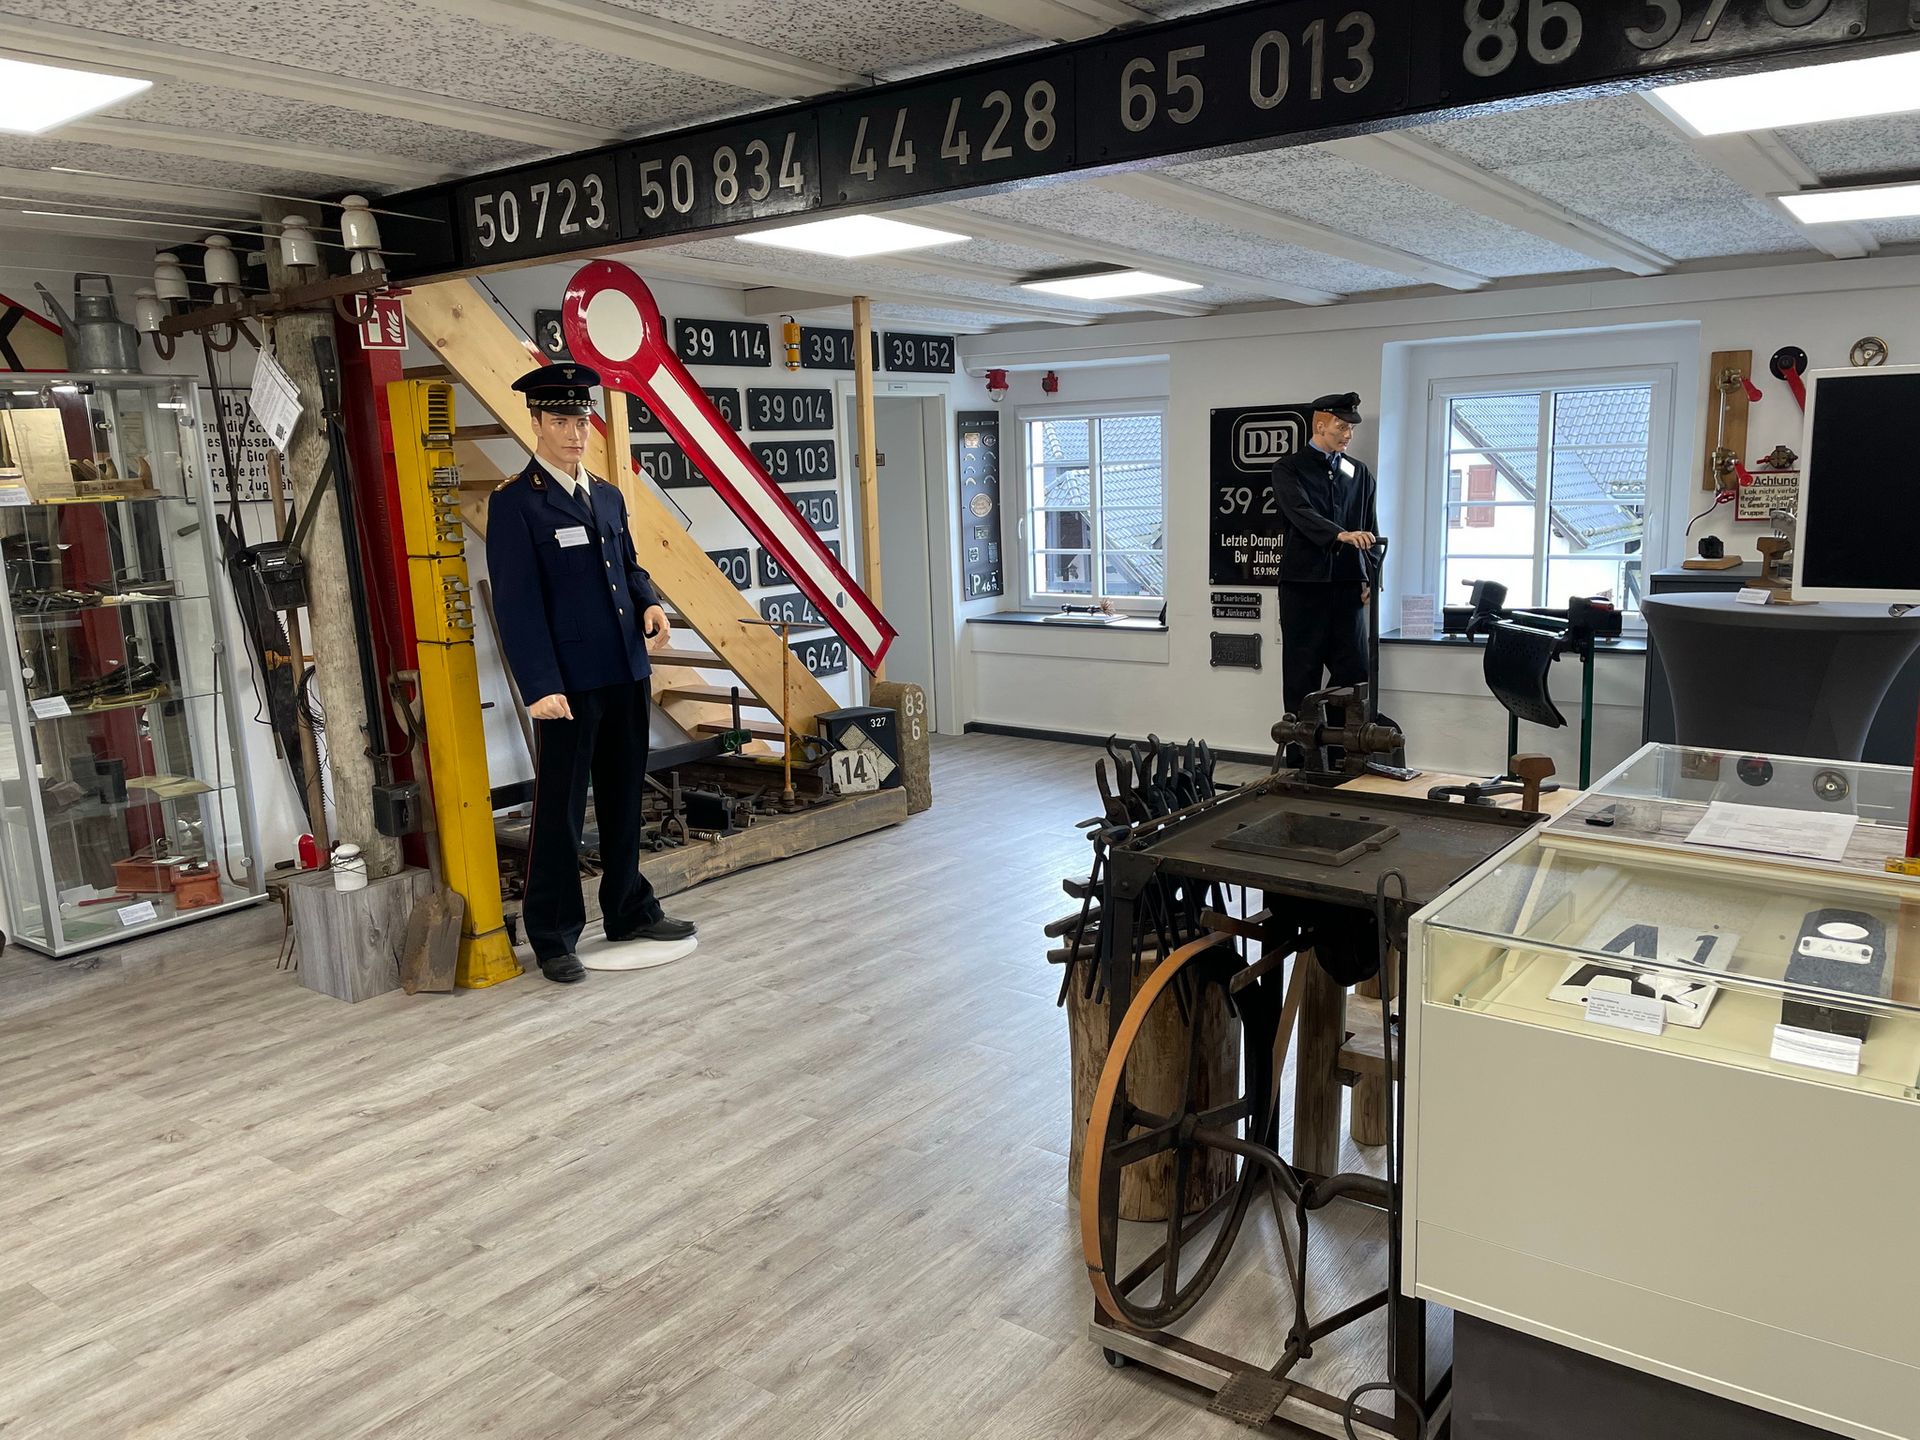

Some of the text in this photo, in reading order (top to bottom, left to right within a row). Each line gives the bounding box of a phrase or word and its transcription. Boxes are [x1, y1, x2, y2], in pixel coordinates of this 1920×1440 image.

[1120, 11, 1376, 132] 65 013
[850, 80, 1056, 181] 44 428
[640, 132, 804, 219] 50 834
[474, 173, 605, 247] 50 723
[546, 320, 563, 353] 3
[684, 326, 766, 359] 39 114
[810, 334, 835, 362] 39
[892, 339, 950, 368] 39 152
[758, 394, 826, 423] 39 014
[1246, 429, 1290, 456] DB
[640, 451, 672, 480] 50
[761, 446, 829, 475] 39 103
[796, 498, 834, 525] 250
[1219, 487, 1278, 515] 39 2
[1221, 533, 1284, 549] Letzte Dampfl
[717, 555, 747, 584] 20
[1234, 550, 1283, 564] Bw Jünke
[973, 574, 981, 594] P
[769, 602, 795, 629] 86
[806, 642, 843, 672] 642
[905, 691, 924, 717] 83
[870, 716, 887, 728] 327
[911, 718, 921, 740] 6
[841, 754, 868, 785] 14
